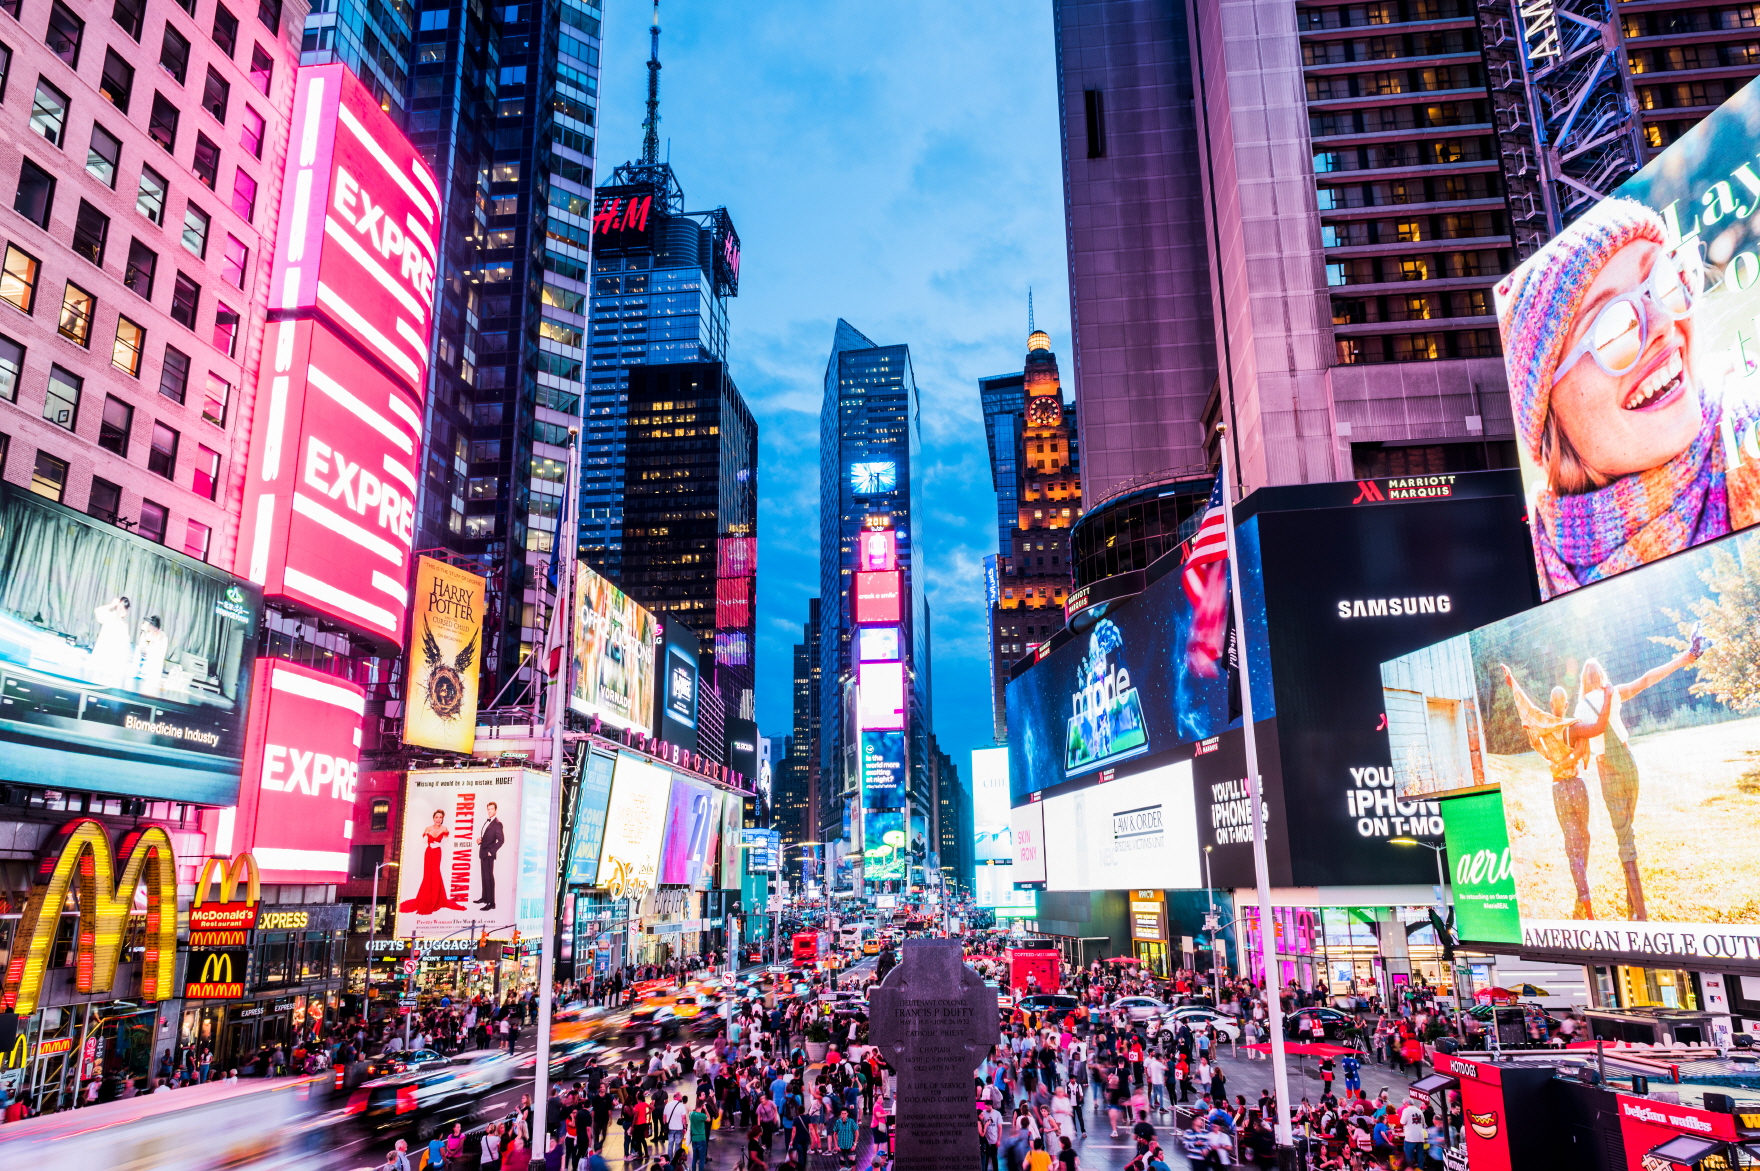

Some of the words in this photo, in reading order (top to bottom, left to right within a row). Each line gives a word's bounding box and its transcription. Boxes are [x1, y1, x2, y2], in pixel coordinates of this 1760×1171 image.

[1518, 0, 1562, 60] AM
[592, 196, 652, 235] H&M
[334, 167, 432, 308] EXPRE
[1389, 476, 1456, 488] MARRIOTT
[304, 443, 414, 542] EXPRE
[1390, 487, 1449, 499] MARQUIS
[867, 517, 888, 526] 2018
[432, 576, 474, 606] HARRY
[428, 592, 475, 624] POTTER
[1337, 594, 1452, 619] SAMSUNG
[432, 615, 453, 628] CURSED
[453, 622, 470, 633] CHILD
[600, 684, 632, 709] VORNADO
[125, 714, 183, 739] Biomedicine
[184, 726, 219, 748] Industry
[874, 776, 894, 784] night?
[454, 793, 475, 841] PRETTY
[1113, 816, 1129, 834] LAW
[1129, 817, 1136, 831] &
[1136, 811, 1163, 829] ORDER
[1357, 817, 1389, 837] ON
[1018, 830, 1030, 844] SKIN
[1216, 827, 1228, 845] ON
[449, 849, 472, 903] WOMAN
[191, 909, 254, 920] McDonald's
[365, 940, 405, 951] GIFTS
[414, 940, 478, 951] LUGGAGE
[1523, 927, 1621, 952] AMERICAN
[1625, 930, 1698, 955] EAGLE
[1702, 934, 1760, 959] OUT
[241, 1007, 264, 1017] EXPRESS
[274, 1003, 296, 1011] EXPRESS
[895, 1008, 932, 1017] FRANCIS
[943, 1007, 975, 1017] DUFFY
[1450, 1060, 1478, 1077] HOTDOGS
[1623, 1103, 1668, 1122] belgian
[1669, 1114, 1713, 1132] waffles
